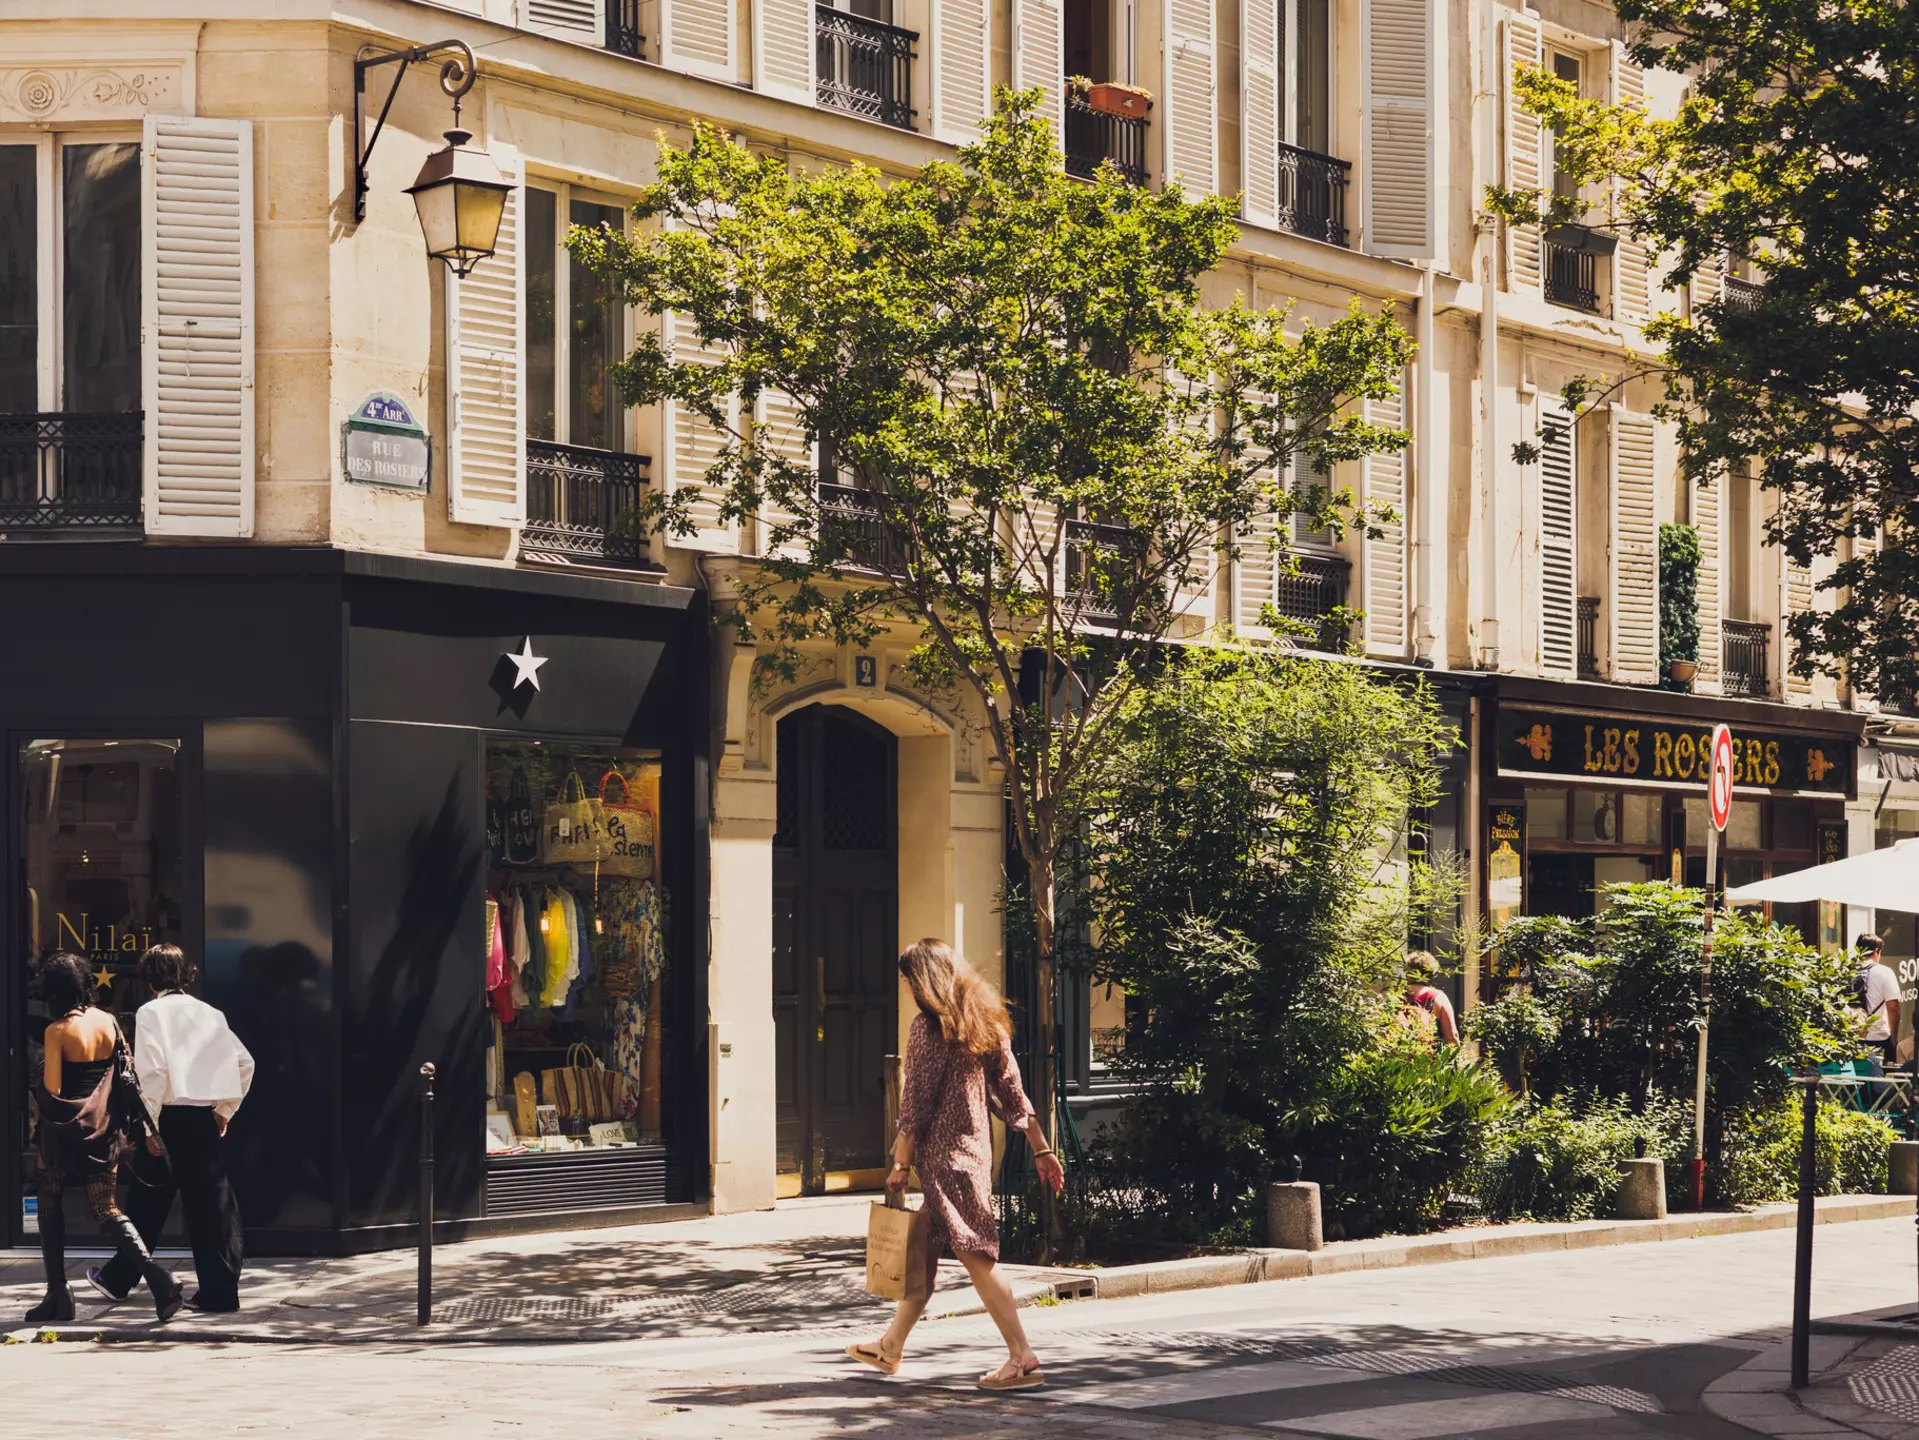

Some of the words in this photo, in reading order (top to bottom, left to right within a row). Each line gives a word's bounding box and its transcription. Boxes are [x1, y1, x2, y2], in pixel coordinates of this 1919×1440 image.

[372, 441, 402, 457] RUE
[347, 456, 372, 473] DES
[375, 461, 425, 479] ROSIERS
[861, 659, 872, 683] 2
[1583, 724, 1640, 775] LES
[1652, 731, 1780, 784] ROSERS
[56, 912, 152, 952] Nilaï
[1898, 958, 1919, 984] SO
[601, 1128, 623, 1139] LOVE
